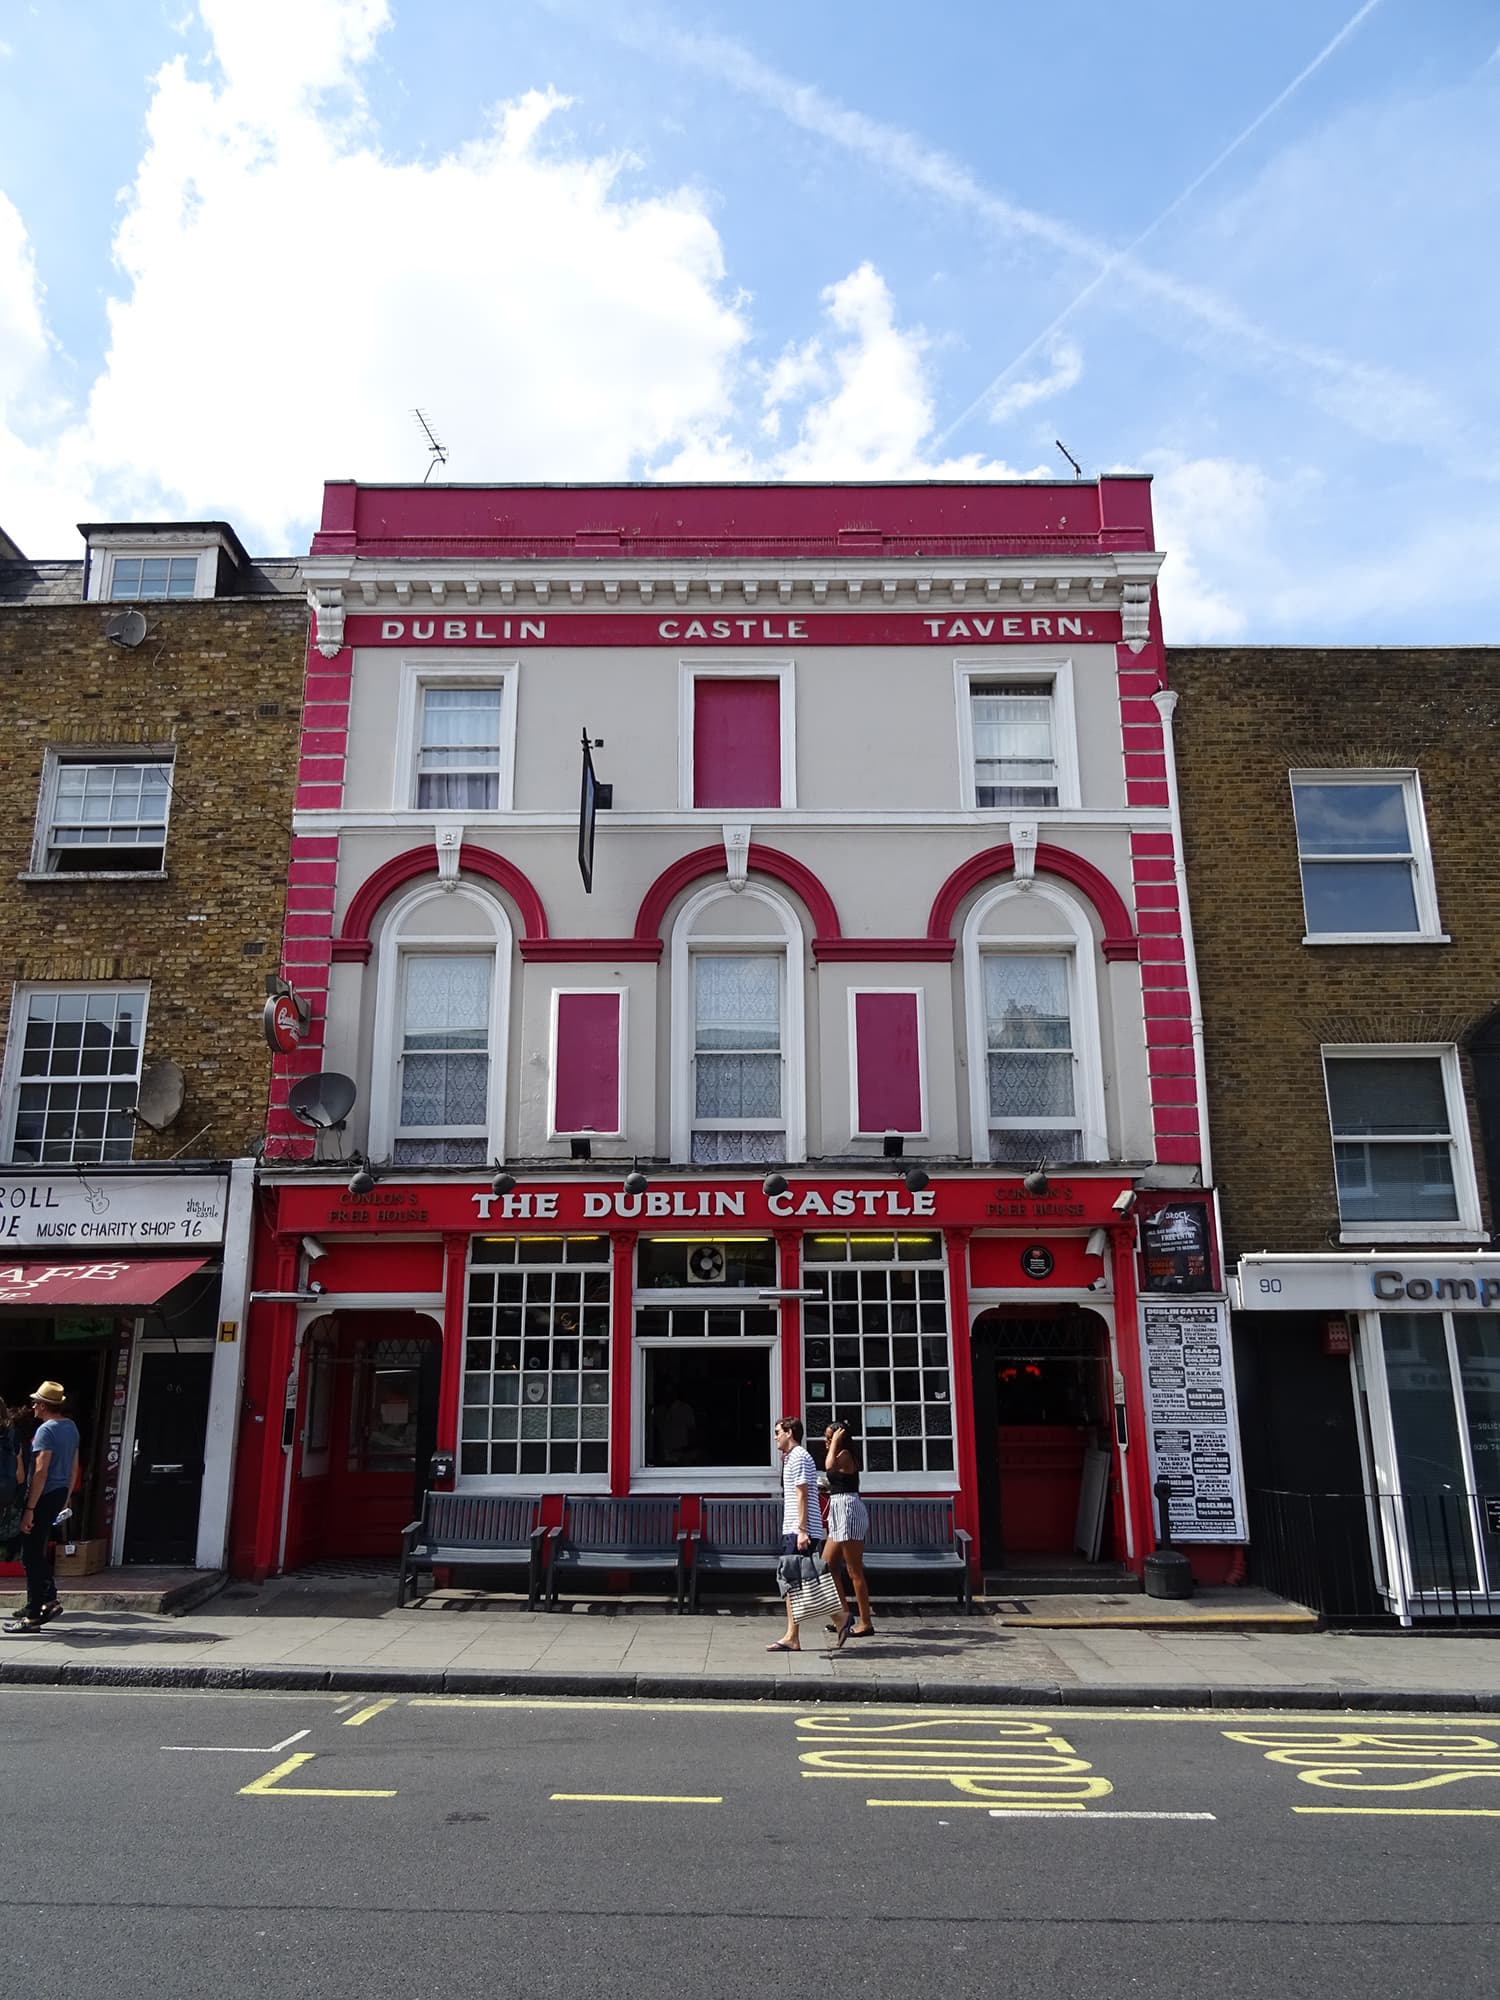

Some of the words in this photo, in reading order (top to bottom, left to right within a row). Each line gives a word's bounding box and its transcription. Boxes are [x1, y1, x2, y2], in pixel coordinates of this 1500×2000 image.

[381, 620, 547, 641] DUBLIN
[658, 619, 809, 640] CASTLE
[923, 616, 1095, 638] TAVERN.
[472, 1193, 559, 1219] THE
[583, 1191, 745, 1218] DUBLIN
[767, 1190, 937, 1217] CASTLE
[986, 1202, 1026, 1217] FREE
[1032, 1202, 1086, 1216] HOUSE
[328, 1209, 369, 1222] FREE
[376, 1208, 429, 1222] HOUSE
[36, 1222, 77, 1238] MUSIC
[80, 1221, 137, 1238] CHARITY
[140, 1221, 176, 1237] SHOP
[180, 1219, 203, 1238] 96
[1260, 1278, 1282, 1293] 90
[222, 1323, 236, 1342] H
[794, 1716, 1114, 1798] STOP
